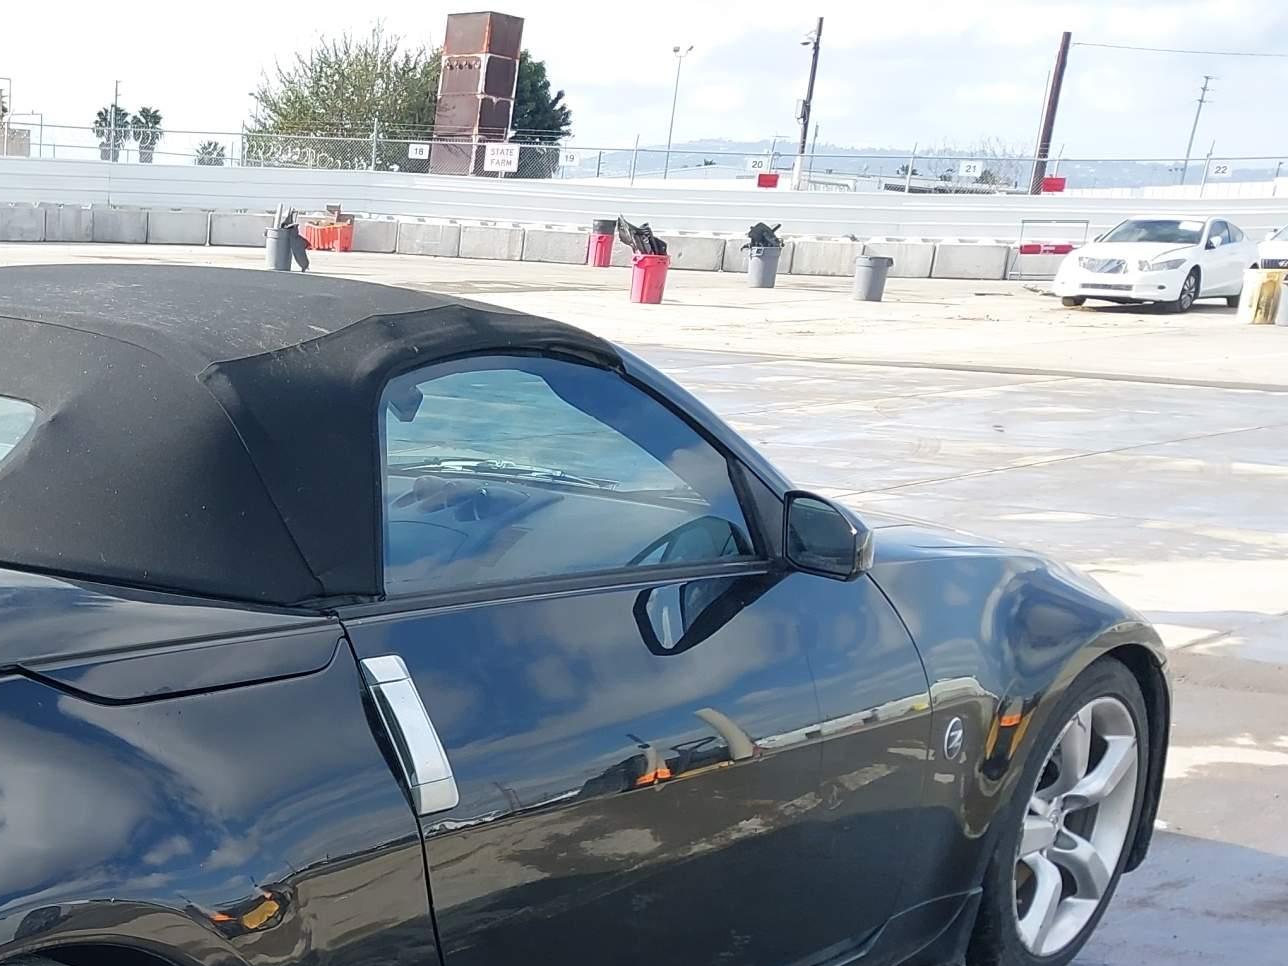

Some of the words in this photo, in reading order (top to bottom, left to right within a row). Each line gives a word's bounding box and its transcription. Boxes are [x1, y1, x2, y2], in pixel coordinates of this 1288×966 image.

[414, 147, 424, 156] 18
[490, 148, 514, 156] STATE
[564, 154, 575, 162] 19
[490, 159, 513, 167] FARM
[751, 160, 763, 168] 20
[965, 164, 977, 173] 21
[1214, 165, 1228, 174] 22
